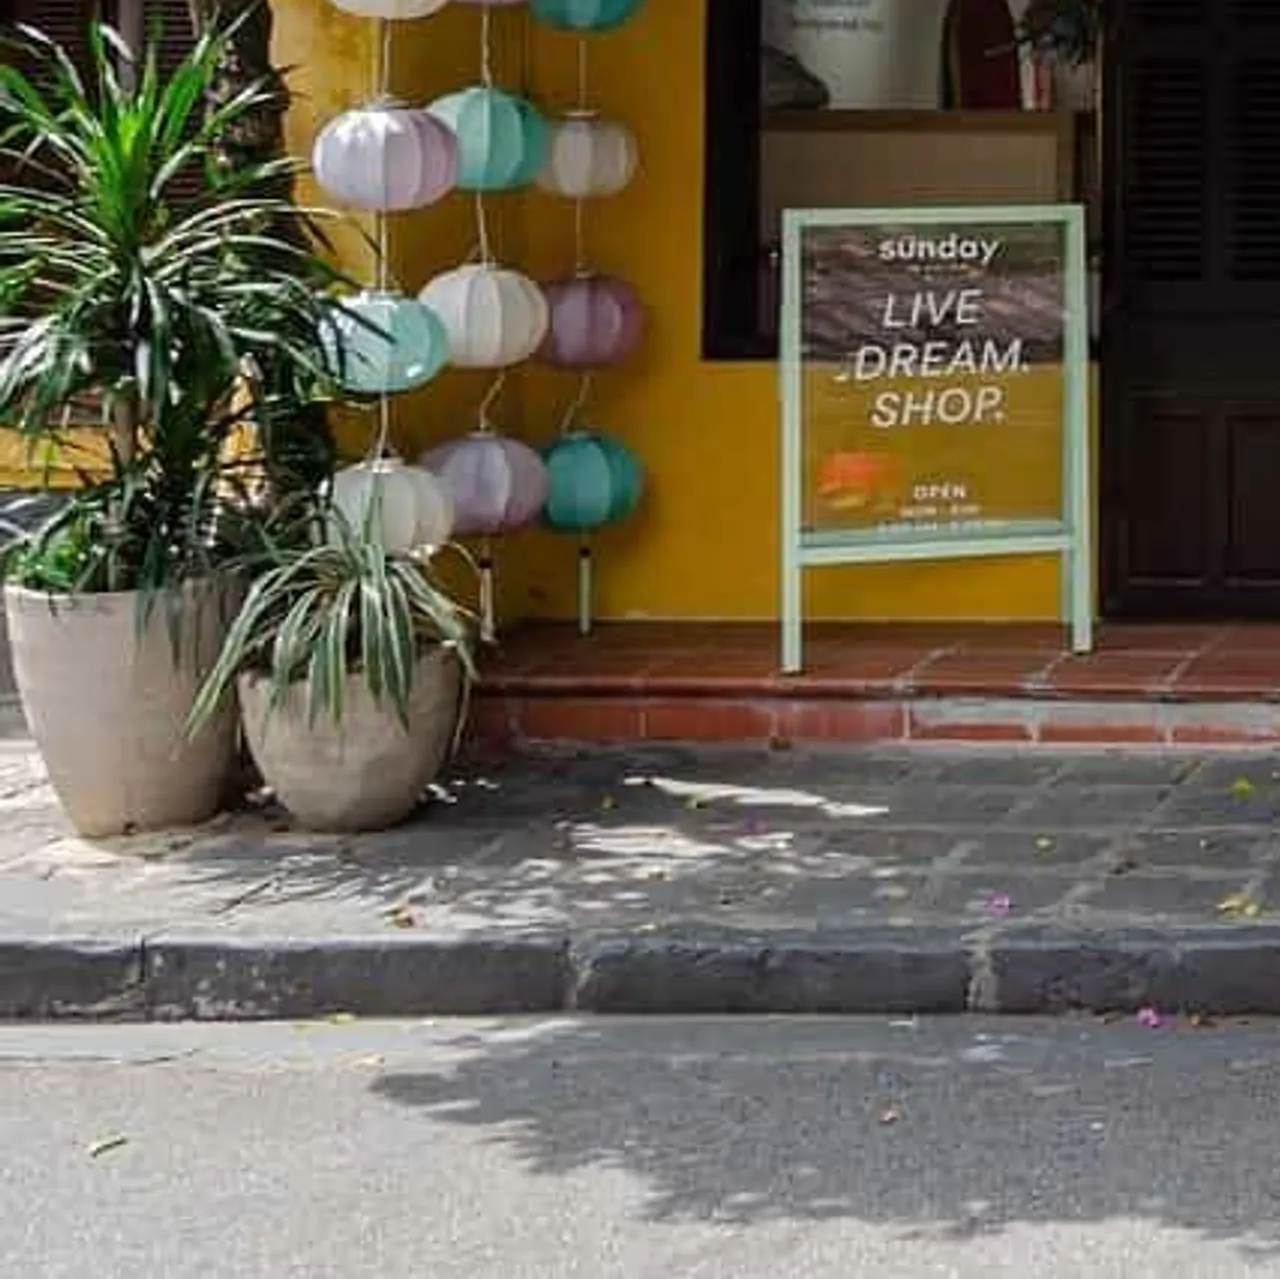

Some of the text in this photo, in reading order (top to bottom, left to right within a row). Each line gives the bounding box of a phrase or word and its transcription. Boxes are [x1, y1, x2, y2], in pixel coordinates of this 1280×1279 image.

[882, 288, 983, 328] LIVE
[854, 338, 1030, 381] DREAM.
[869, 385, 1004, 428] SHOP.
